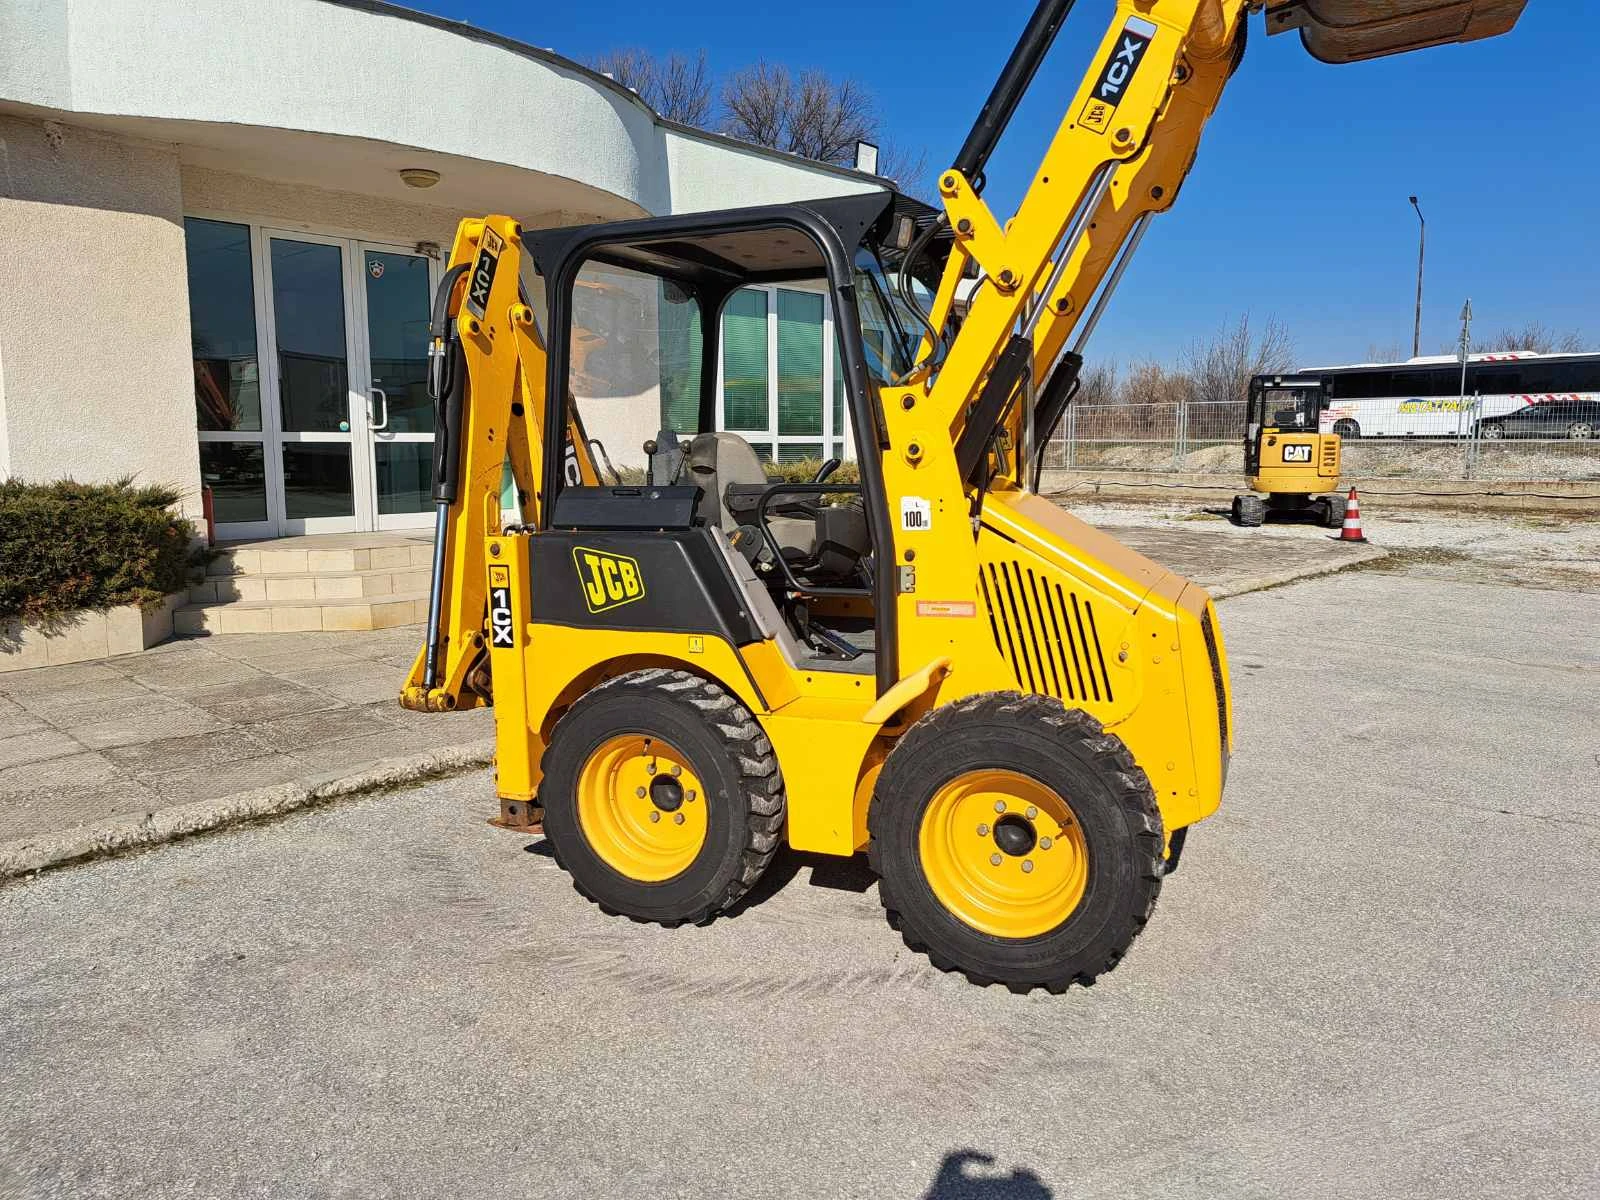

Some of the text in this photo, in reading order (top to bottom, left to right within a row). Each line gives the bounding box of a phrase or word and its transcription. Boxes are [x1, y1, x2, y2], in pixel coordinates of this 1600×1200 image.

[1101, 37, 1143, 97] 1CX
[1087, 105, 1105, 123] JCB
[472, 256, 491, 304] 1CX
[1284, 446, 1311, 461] CAT
[904, 510, 922, 527] 100
[584, 554, 639, 606] JCB
[493, 589, 513, 644] 1CX
